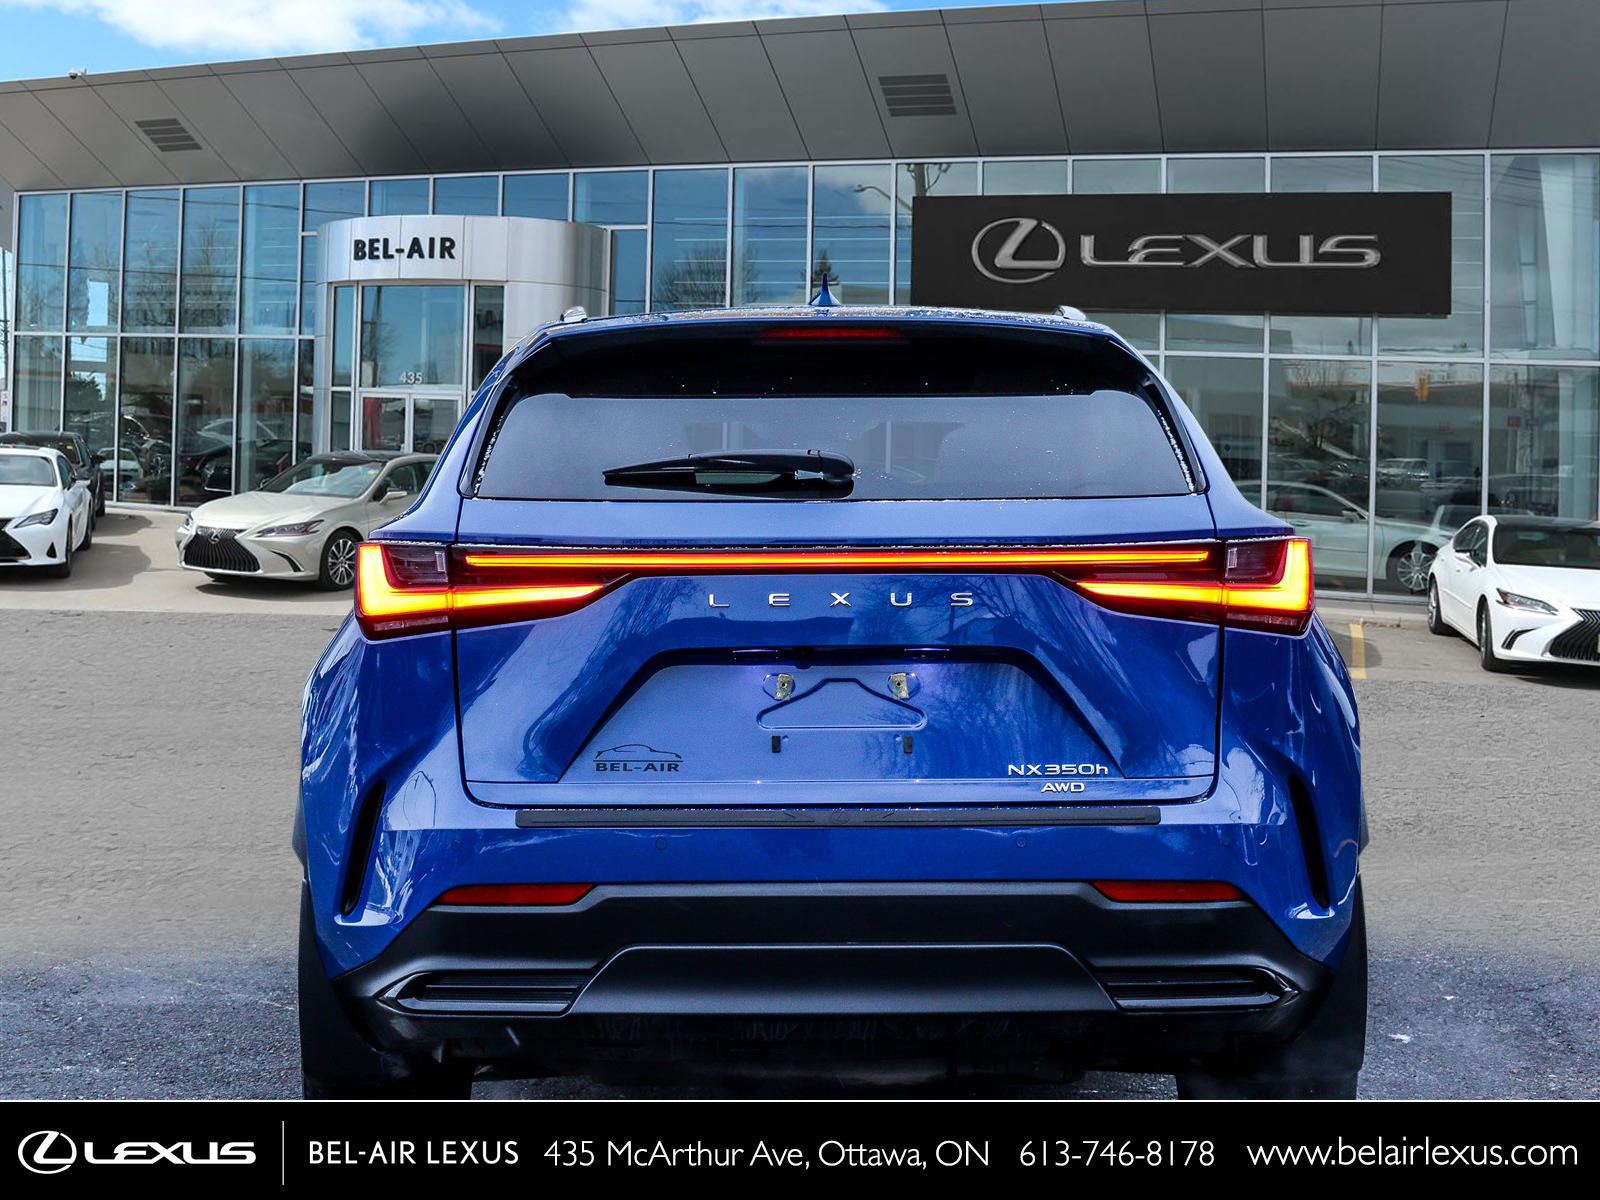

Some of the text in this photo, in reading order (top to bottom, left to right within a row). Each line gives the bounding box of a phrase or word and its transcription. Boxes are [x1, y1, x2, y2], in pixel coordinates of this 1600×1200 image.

[353, 237, 456, 261] BEL-AIR
[1080, 234, 1381, 268] LEXUS
[399, 371, 423, 384] 435
[708, 592, 974, 608] LEXUS
[595, 762, 680, 772] BEL-AIR
[1008, 764, 1109, 776] NX350h
[1040, 782, 1085, 793] AWD
